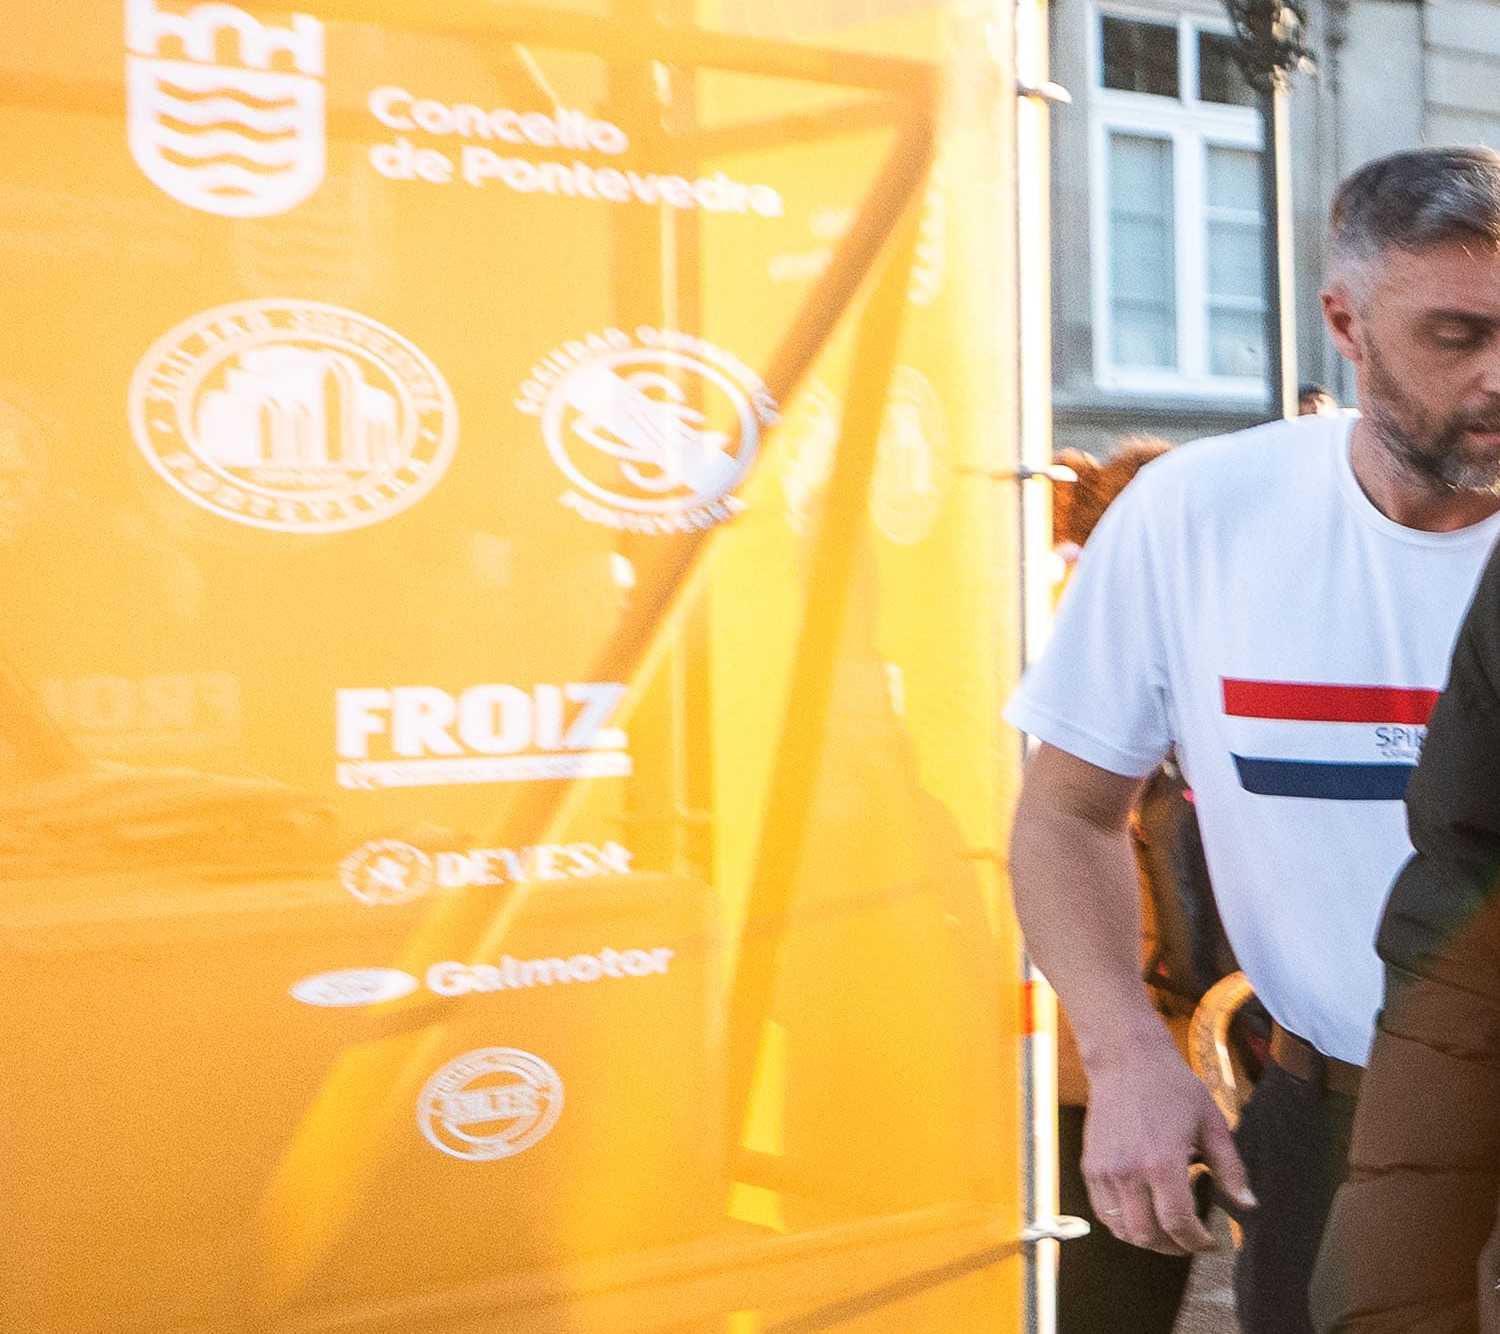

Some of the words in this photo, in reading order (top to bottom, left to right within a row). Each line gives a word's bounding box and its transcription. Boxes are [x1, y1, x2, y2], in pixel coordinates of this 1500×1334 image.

[366, 85, 629, 155] Concello
[368, 137, 453, 184] de
[461, 144, 785, 217] Pontevedra
[335, 681, 630, 760] FROIZ
[433, 840, 635, 889] DEVESA
[425, 946, 676, 997] Galmotor
